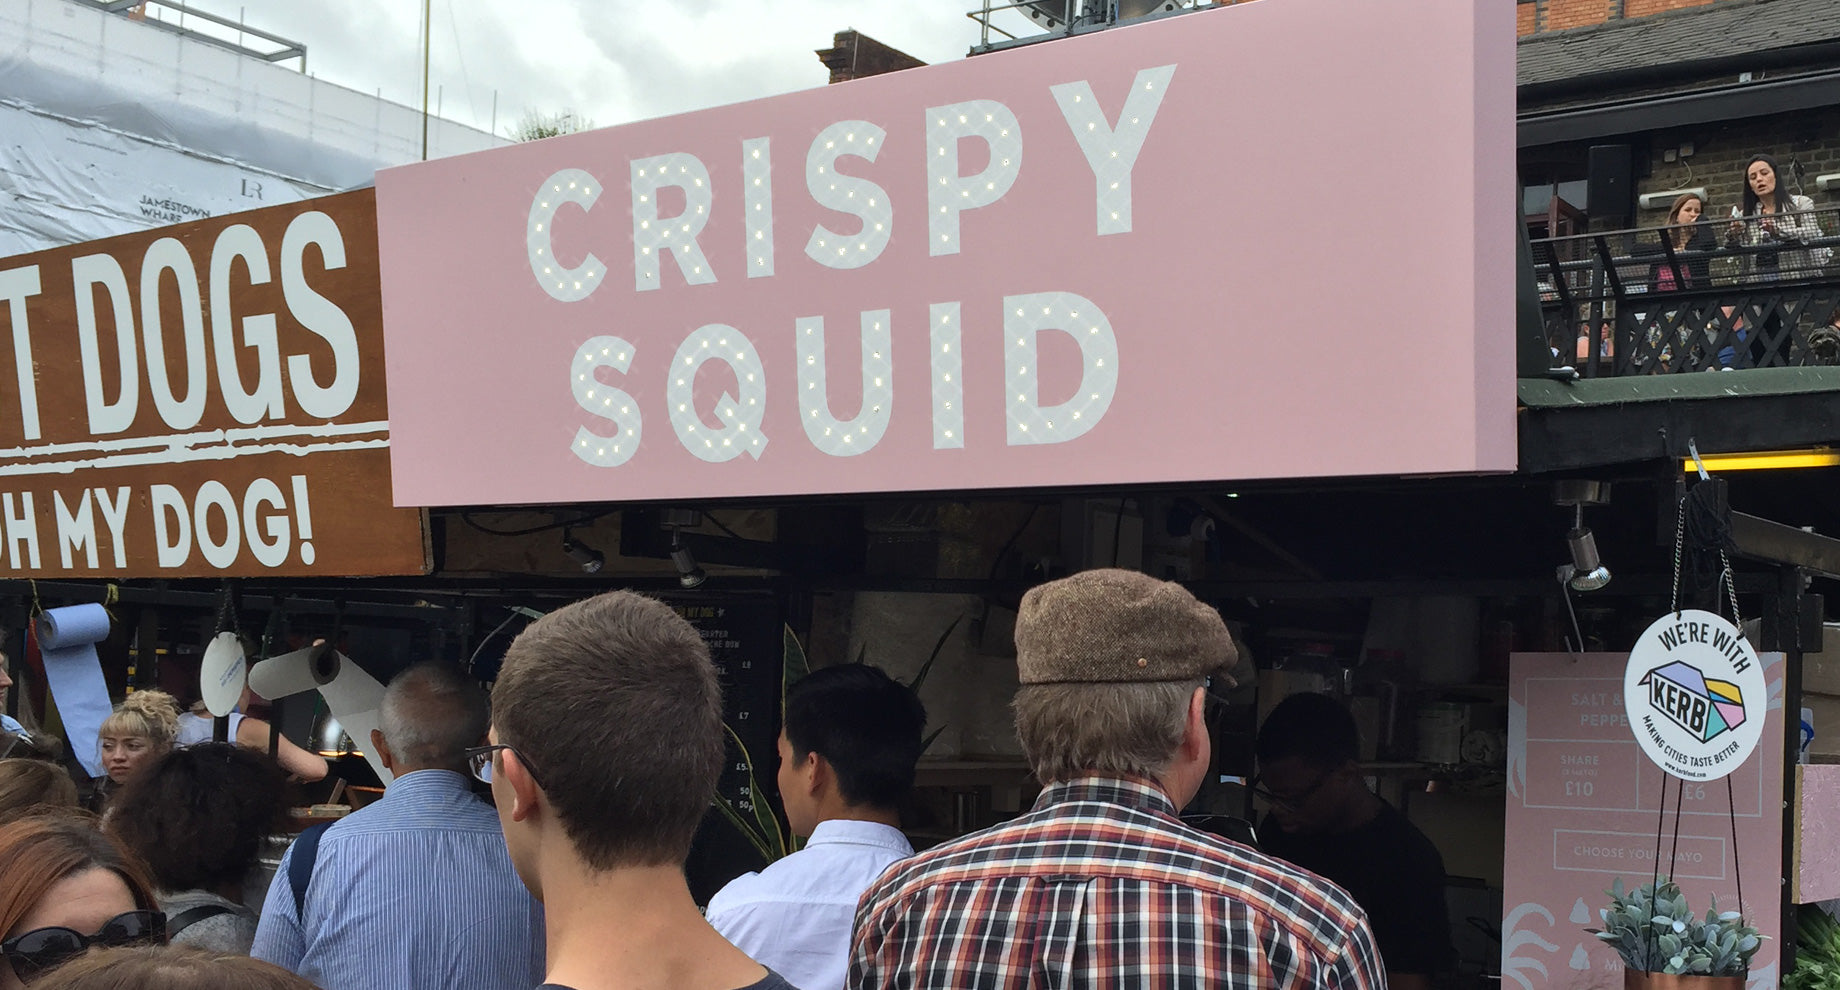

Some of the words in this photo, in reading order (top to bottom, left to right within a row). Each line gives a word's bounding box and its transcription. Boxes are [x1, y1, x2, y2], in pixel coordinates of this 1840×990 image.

[527, 63, 1178, 303] CRISPY
[140, 195, 211, 219] JAMESTOWN
[140, 207, 182, 223] WHARF
[71, 210, 360, 435] DOGS
[569, 291, 1119, 468] SQUID
[0, 491, 41, 569] H
[53, 486, 131, 569] MY
[150, 475, 316, 568] DOG!
[1658, 622, 1709, 652] WE'RE
[1713, 629, 1752, 675] WITH
[1571, 693, 1607, 706] SALT
[1612, 693, 1623, 706] &
[1653, 677, 1707, 733] KERB
[1580, 714, 1628, 726] PEPPE
[1642, 715, 1665, 749] MAKING
[1664, 745, 1688, 765] CITIES
[1690, 756, 1713, 767] TASTE
[1714, 740, 1740, 764] BETTER
[1560, 755, 1599, 765] SHARE
[1565, 781, 1593, 796] £10
[1684, 785, 1706, 800] £6
[739, 801, 754, 812] 50p
[1574, 846, 1624, 858] CHOOSE
[1667, 852, 1703, 863] MAYO
